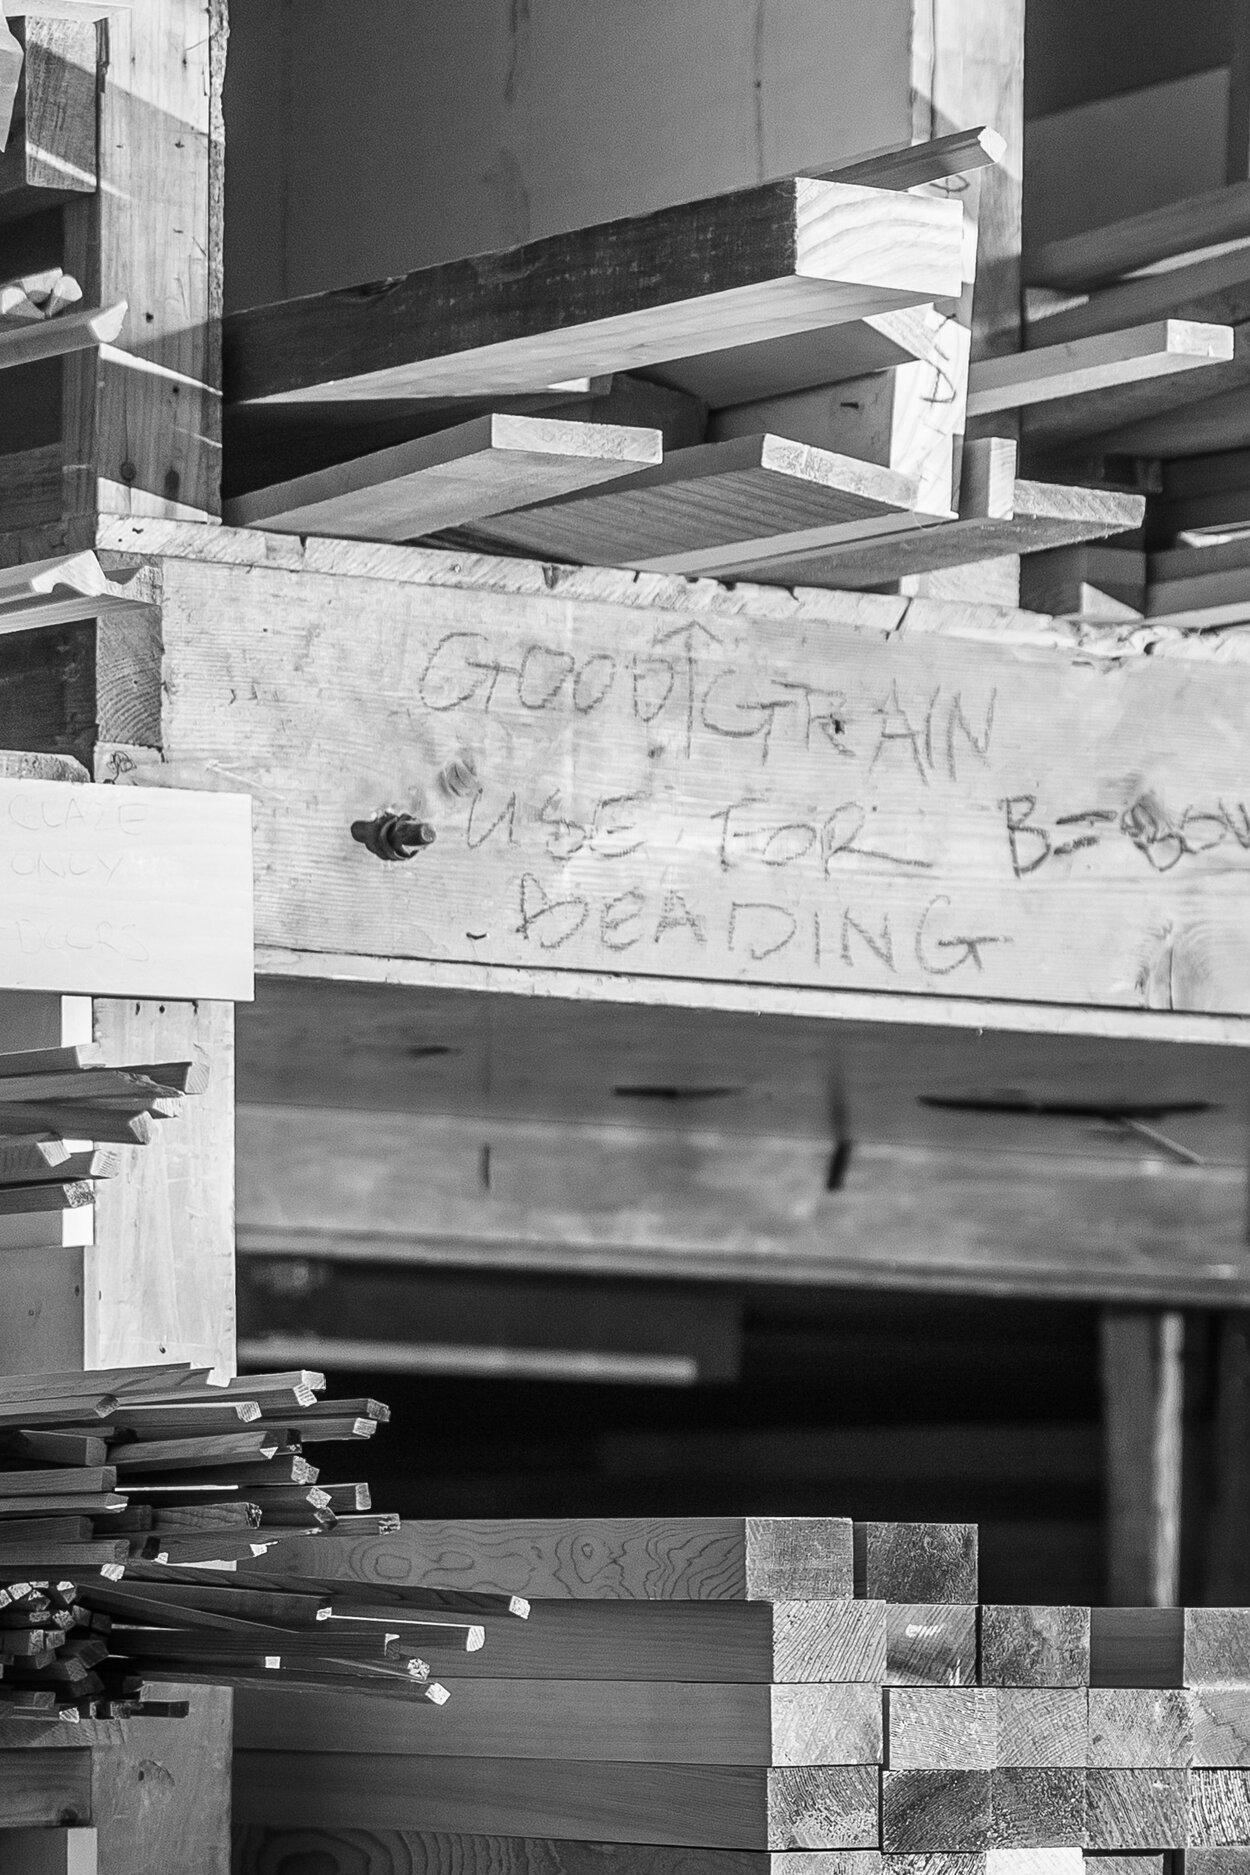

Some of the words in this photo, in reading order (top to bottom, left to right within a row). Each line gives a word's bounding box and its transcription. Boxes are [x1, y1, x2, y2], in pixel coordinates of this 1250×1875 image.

[418, 631, 675, 724] GOOD
[700, 669, 997, 786] GRAIN
[465, 788, 650, 863] USE
[710, 797, 933, 881] FOR
[515, 872, 1015, 976] BEADING
